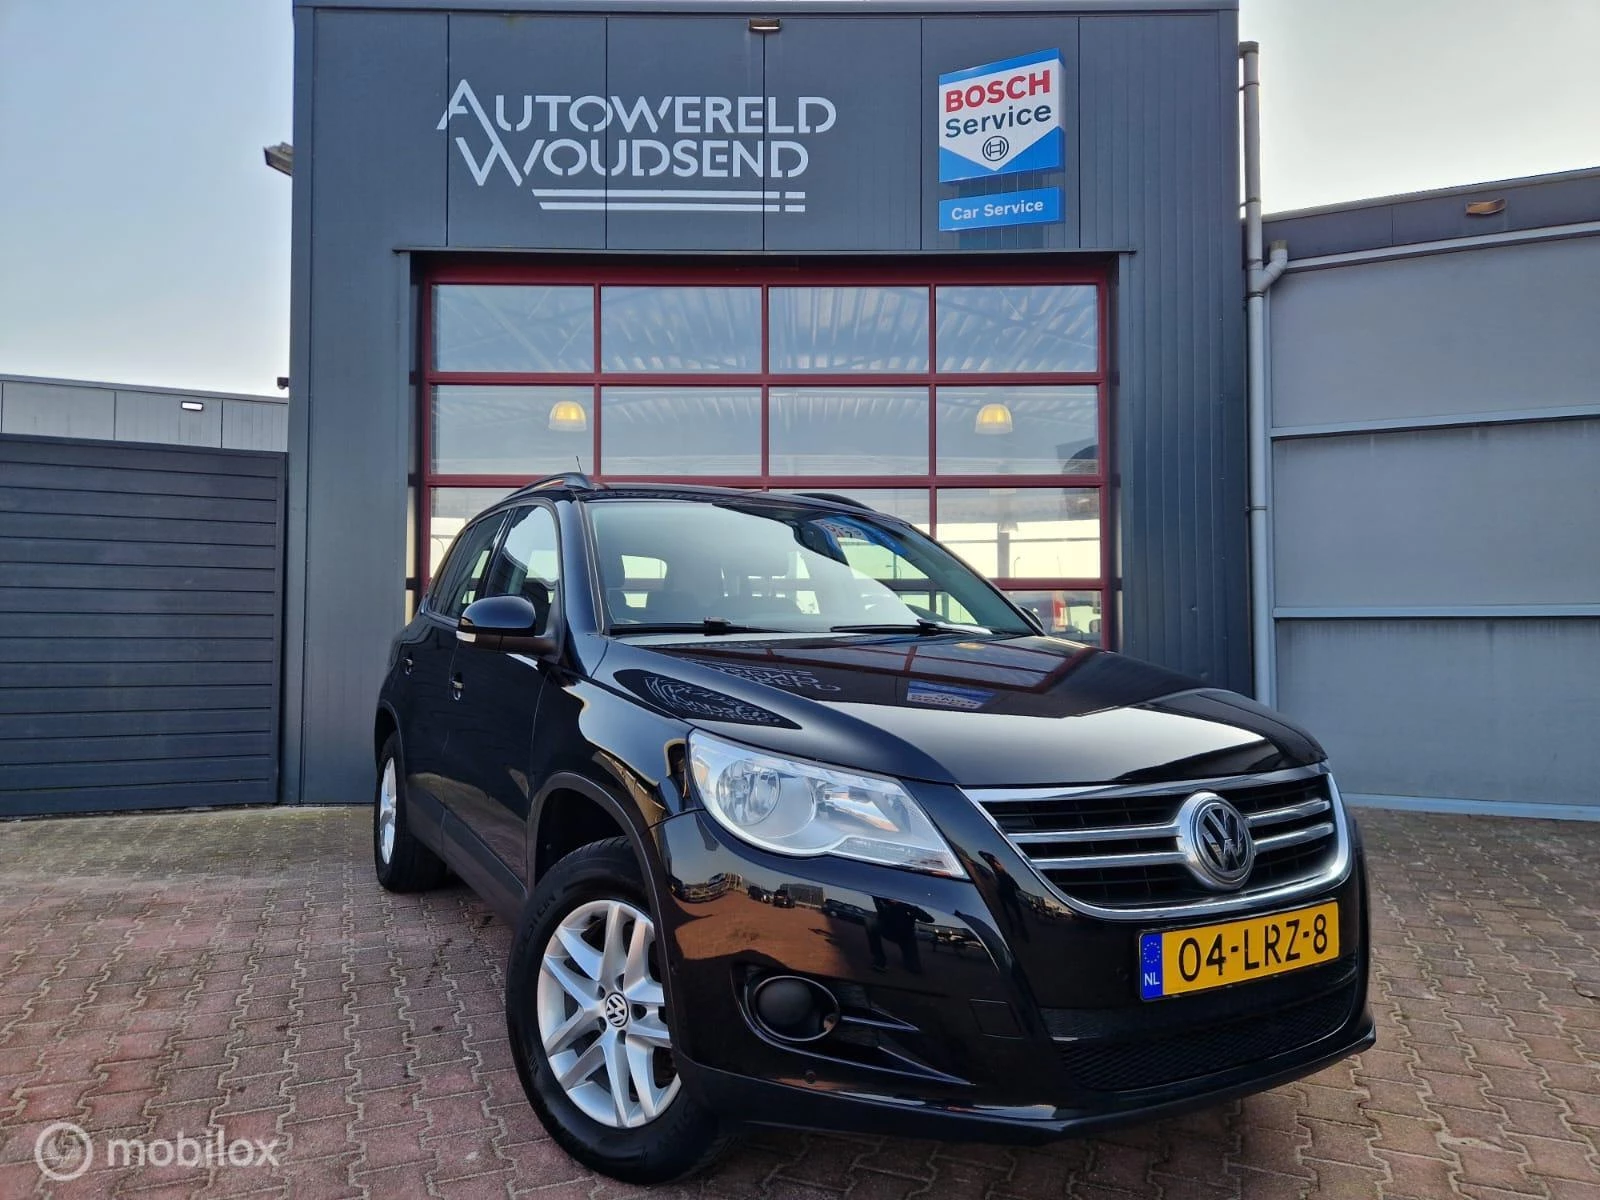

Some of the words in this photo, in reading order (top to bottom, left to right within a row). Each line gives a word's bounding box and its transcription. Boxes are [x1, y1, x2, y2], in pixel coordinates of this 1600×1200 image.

[436, 79, 837, 134] AUTOWERELD
[945, 69, 1051, 113] BOSCH
[945, 104, 1051, 138] Service
[455, 136, 809, 187] WOUDSEND
[951, 207, 979, 221] Car
[983, 199, 1044, 217] Service
[1178, 913, 1328, 982] 04-LRZ-8
[1144, 972, 1161, 987] NL
